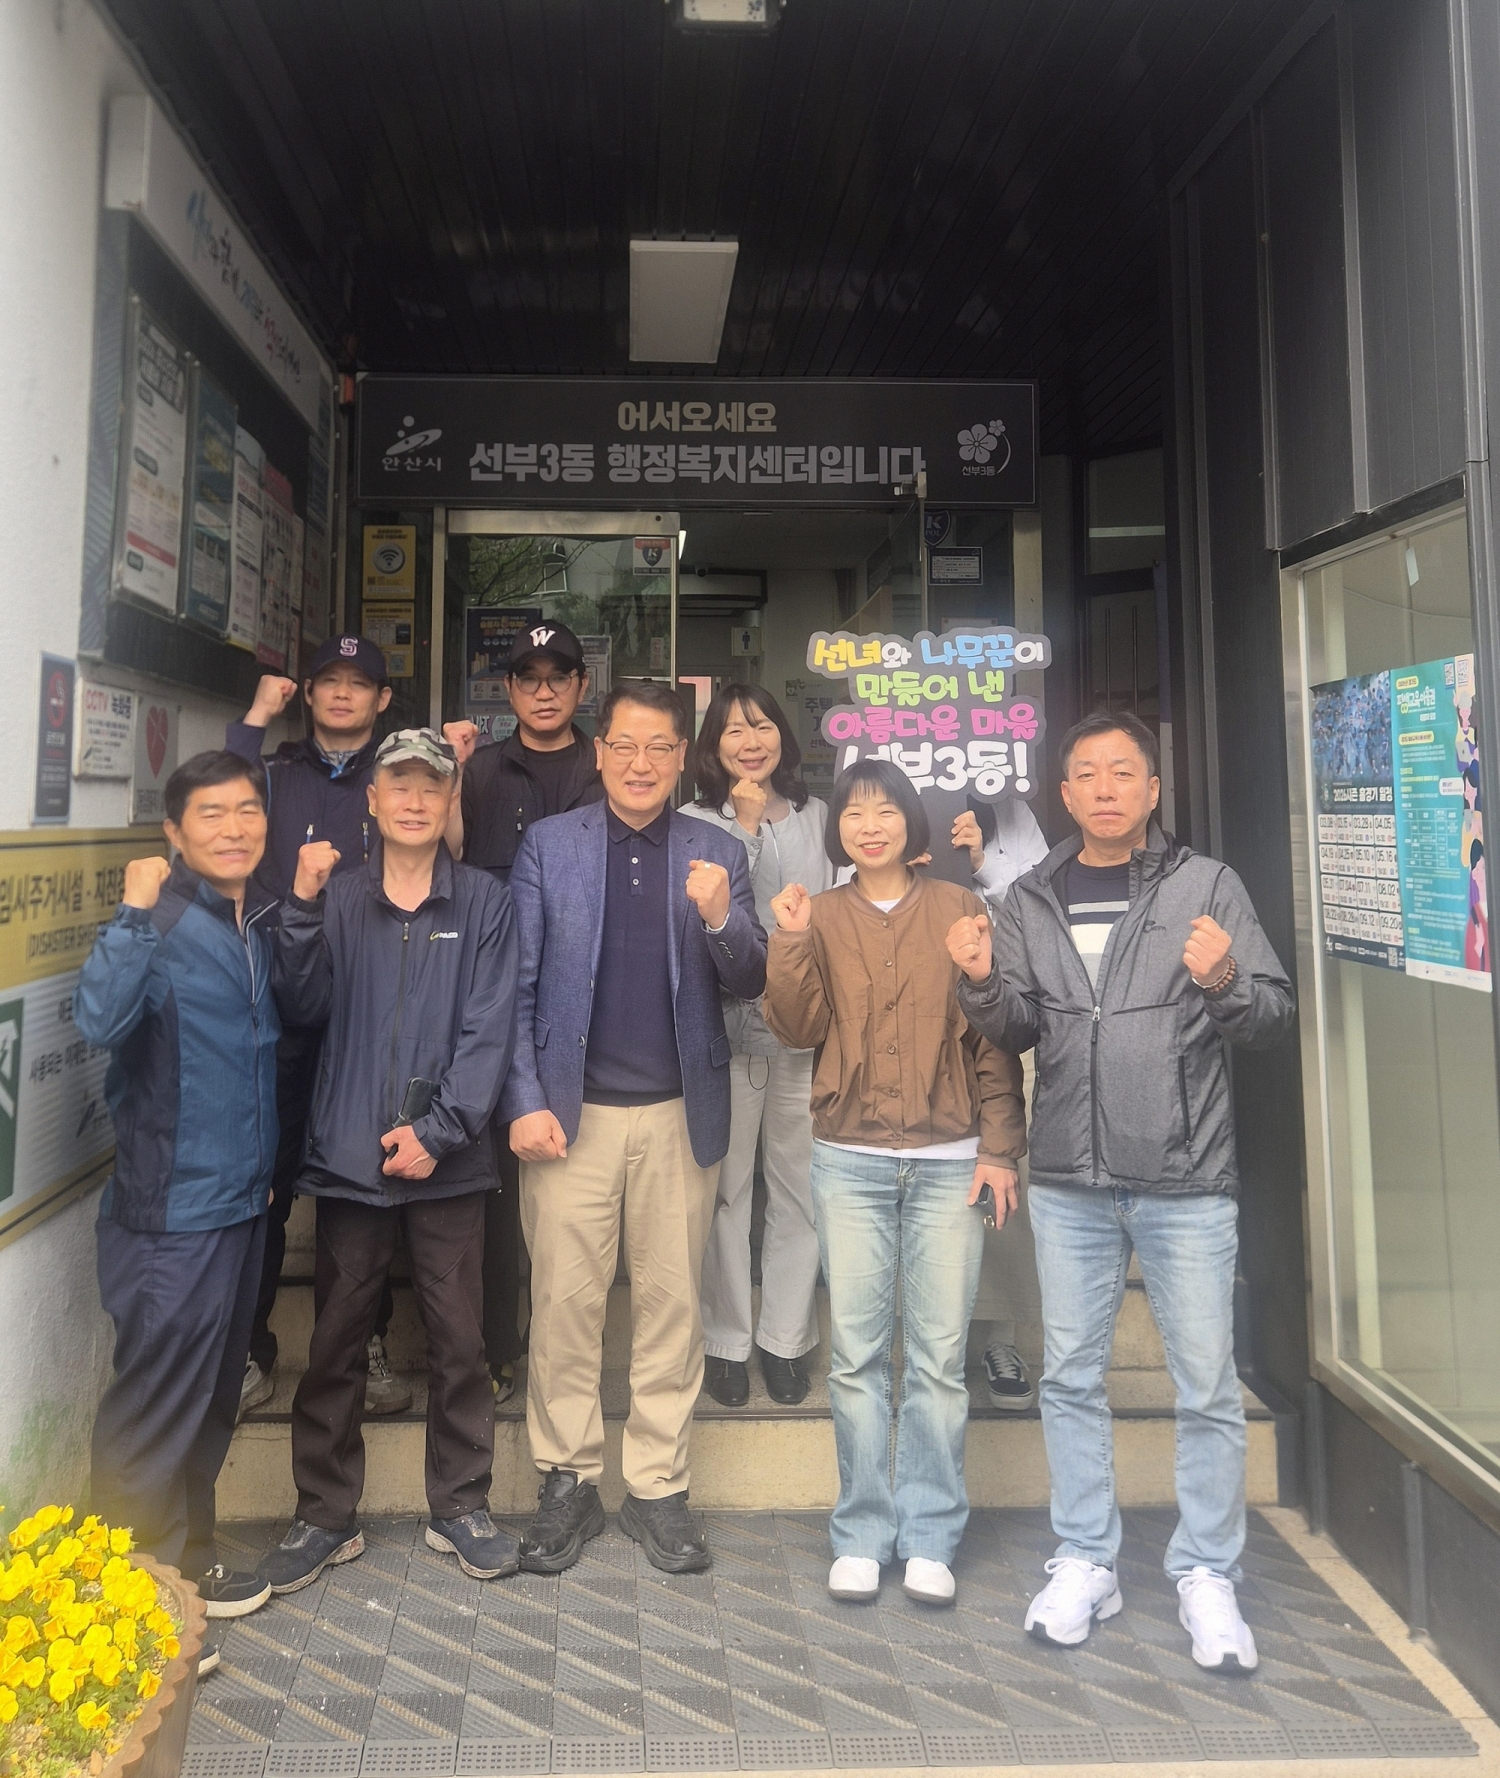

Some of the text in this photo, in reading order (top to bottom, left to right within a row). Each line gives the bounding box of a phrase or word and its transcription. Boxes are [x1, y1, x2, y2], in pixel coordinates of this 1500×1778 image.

[617, 400, 778, 433] 어서오세요
[382, 456, 442, 472] 안산시
[469, 442, 926, 485] 선부3동 행정복지센터입니다
[961, 465, 996, 477] 선부3동
[529, 626, 556, 647] W
[339, 636, 359, 657] S
[813, 633, 1044, 672] 선녀와 나무꾼이
[855, 669, 1006, 706] 만들어 낸
[85, 689, 109, 712] CCTV
[828, 704, 961, 744] 아름다운
[970, 703, 1039, 740] 마을
[1359, 786, 1378, 802] 홈경기
[1379, 786, 1393, 802] 일정
[1353, 817, 1369, 829] 03.28
[1375, 817, 1392, 829] 04.05
[1377, 850, 1393, 862] 05.16
[1378, 883, 1396, 896] 08.02
[1381, 916, 1398, 929] 09.20
